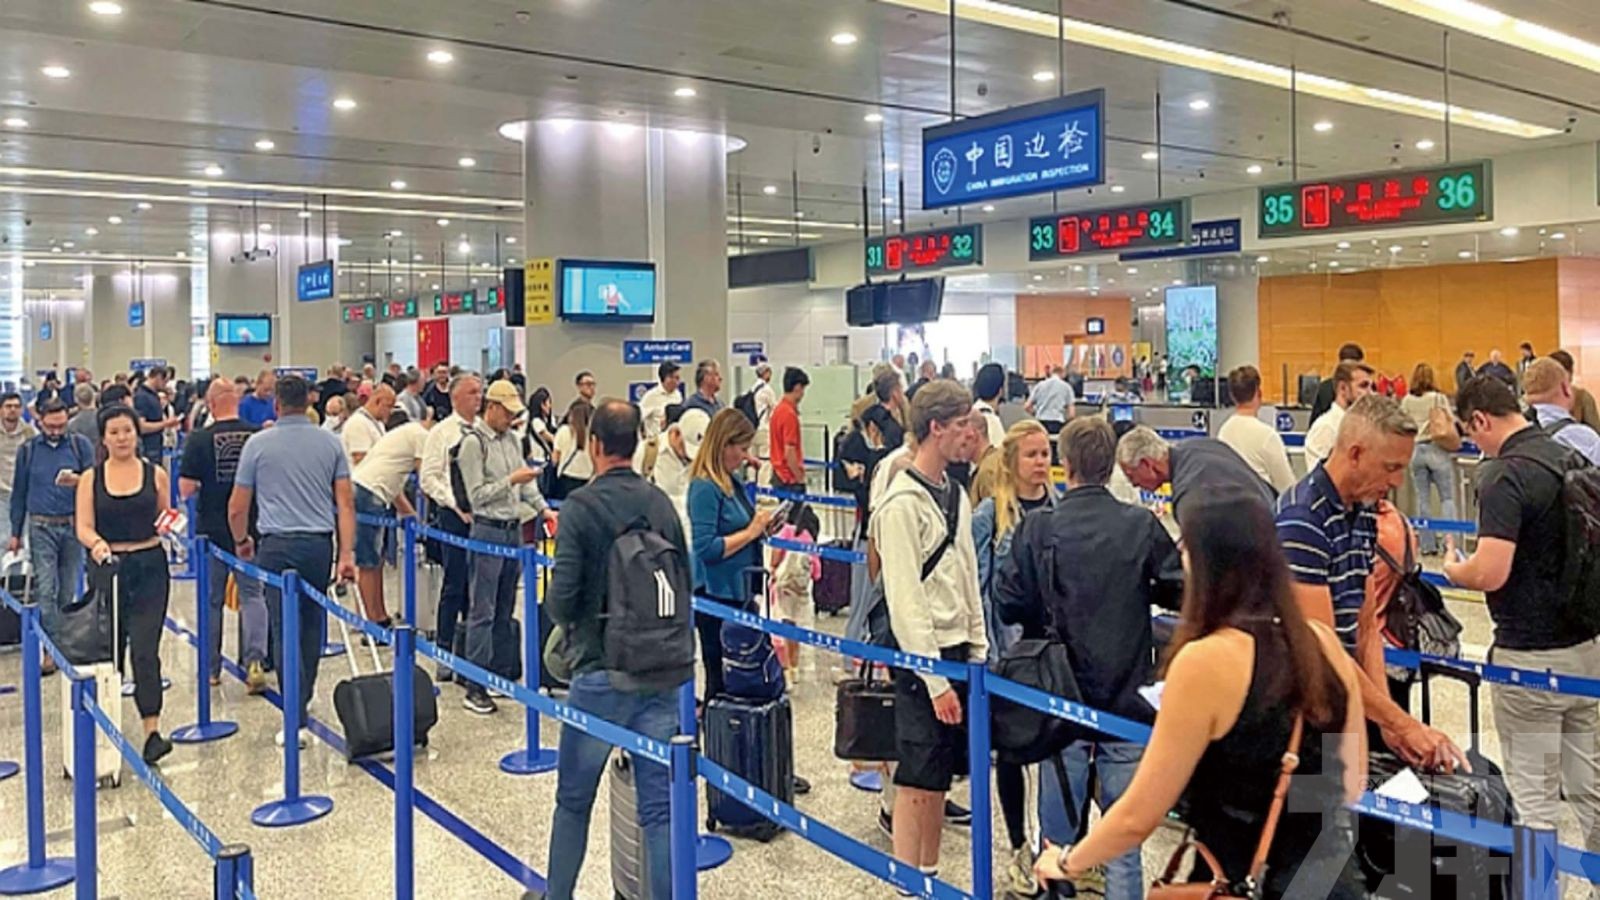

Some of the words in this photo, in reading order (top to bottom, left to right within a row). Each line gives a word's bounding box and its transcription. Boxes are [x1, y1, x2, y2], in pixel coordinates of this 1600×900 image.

[964, 120, 1089, 175] 中国边检
[965, 180, 988, 191] CHINA
[990, 171, 1038, 188] IMMIGRATION
[1041, 163, 1089, 179] INSPECTION
[1438, 174, 1475, 208] 36
[1264, 195, 1294, 225] 35
[1032, 225, 1054, 250] 33
[1150, 211, 1174, 238] 34
[867, 246, 882, 267] 31
[952, 234, 972, 257] 32
[671, 342, 691, 352] Card
